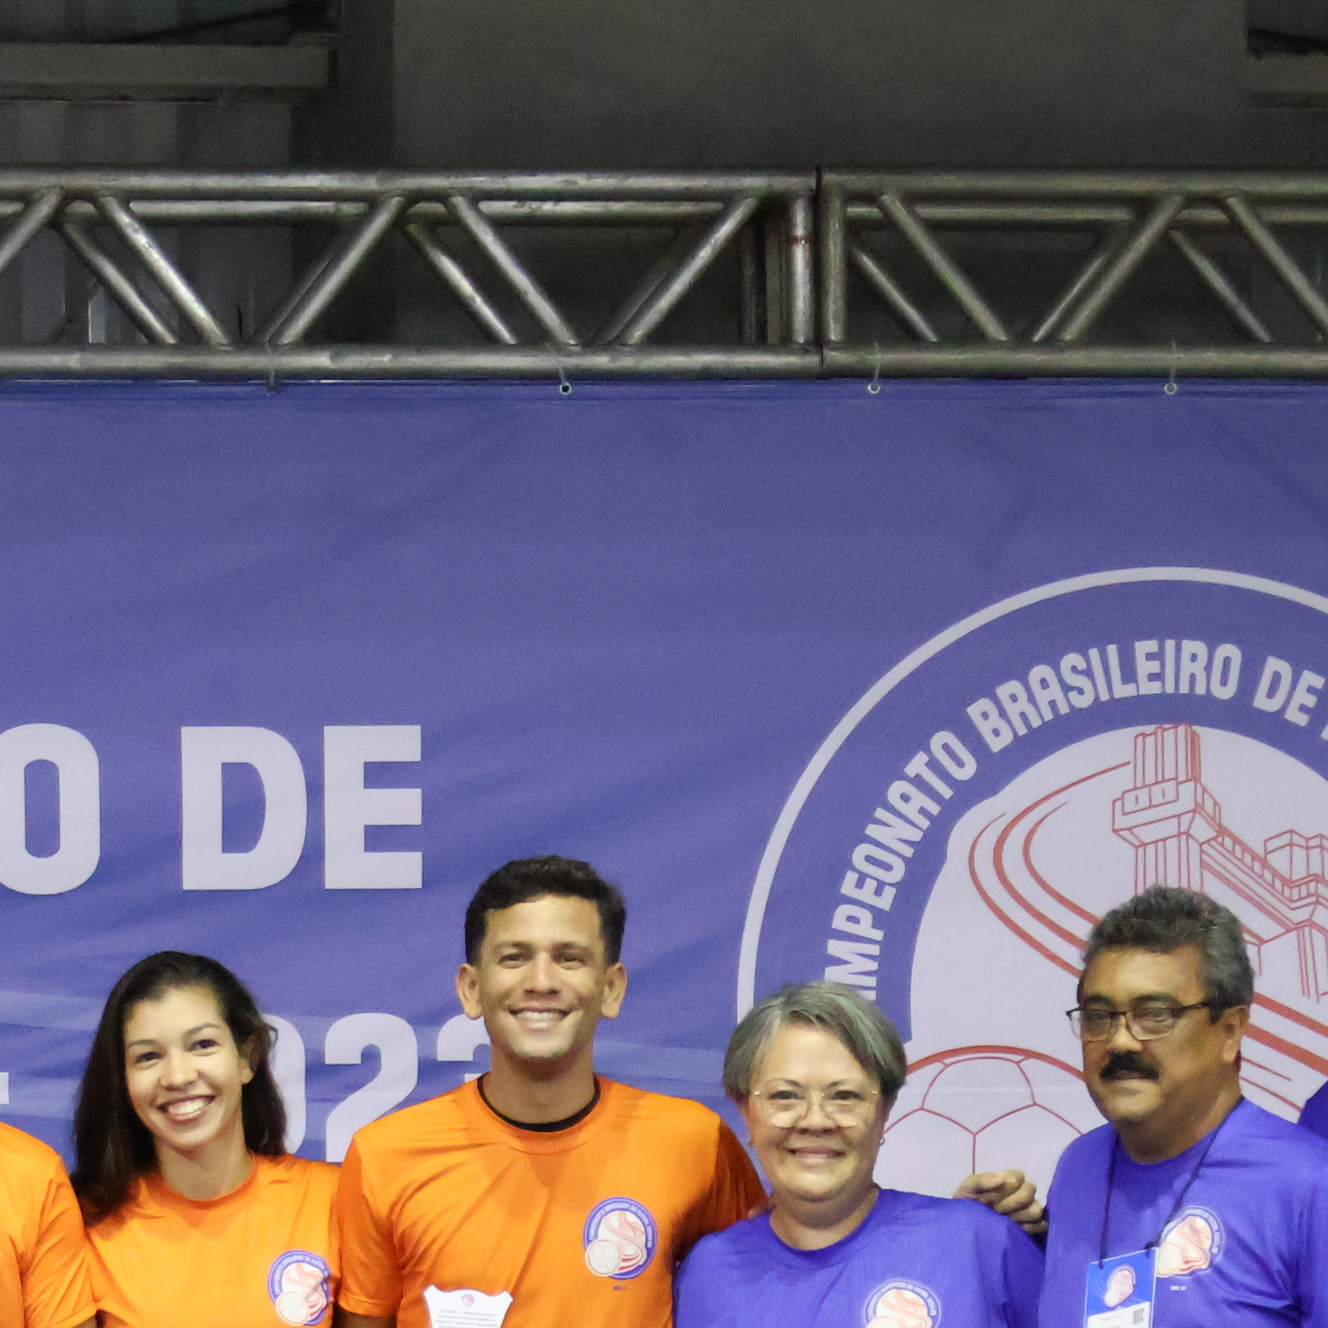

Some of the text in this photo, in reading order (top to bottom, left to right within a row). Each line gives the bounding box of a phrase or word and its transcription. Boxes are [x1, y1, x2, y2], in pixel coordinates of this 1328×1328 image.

[966, 639, 1242, 753] BRASILEIRO
[1253, 656, 1326, 727] DE
[180, 724, 423, 891] DE
